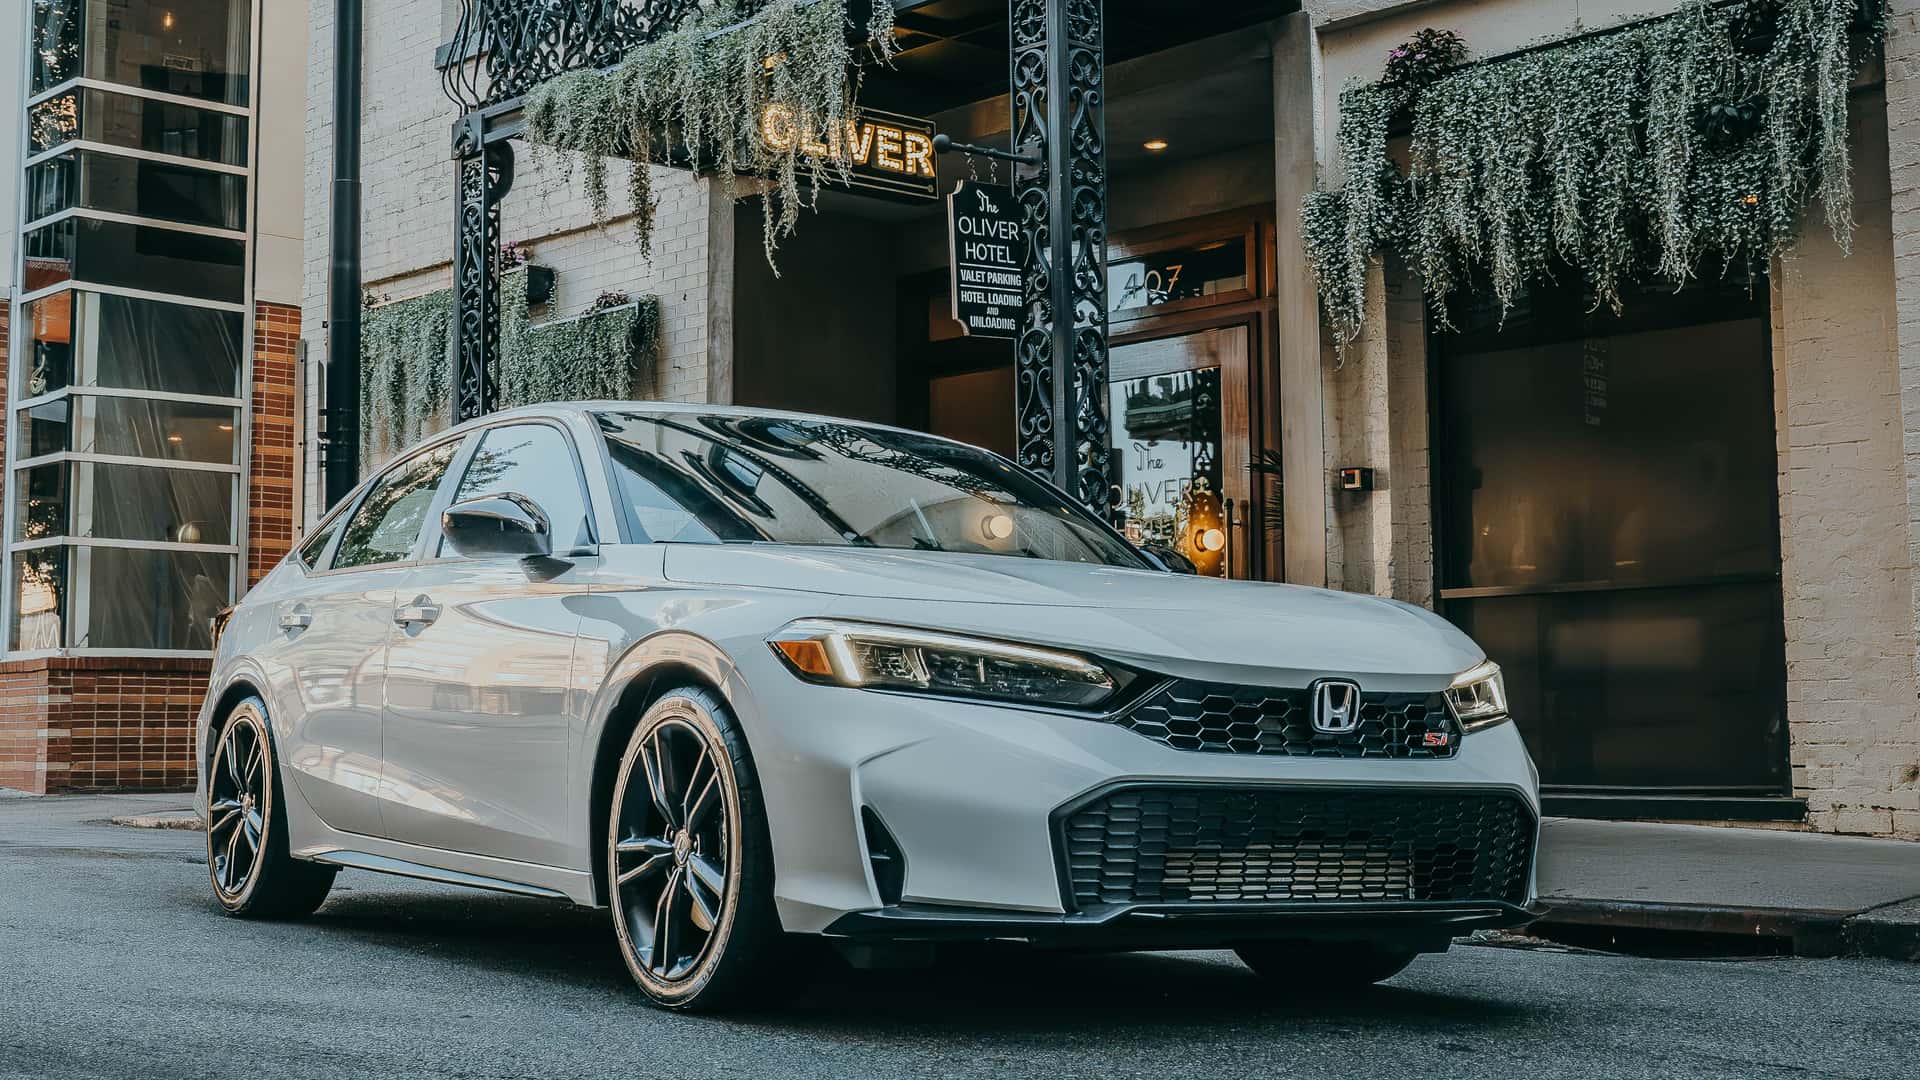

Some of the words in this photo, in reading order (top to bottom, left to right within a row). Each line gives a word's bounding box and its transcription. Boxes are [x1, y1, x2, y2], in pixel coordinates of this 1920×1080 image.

[761, 104, 935, 177] OLIVER
[976, 189, 999, 213] The
[958, 216, 1019, 241] OLIVER
[965, 241, 1016, 264] HOTEL
[960, 269, 986, 283] VALET
[987, 272, 1022, 287] PARKING
[1124, 265, 1183, 299] 407
[960, 290, 987, 304] HOTEL
[988, 293, 1023, 307] LOADING
[986, 307, 999, 316] AND
[969, 316, 1016, 331] UNLOADING
[1133, 442, 1163, 472] The
